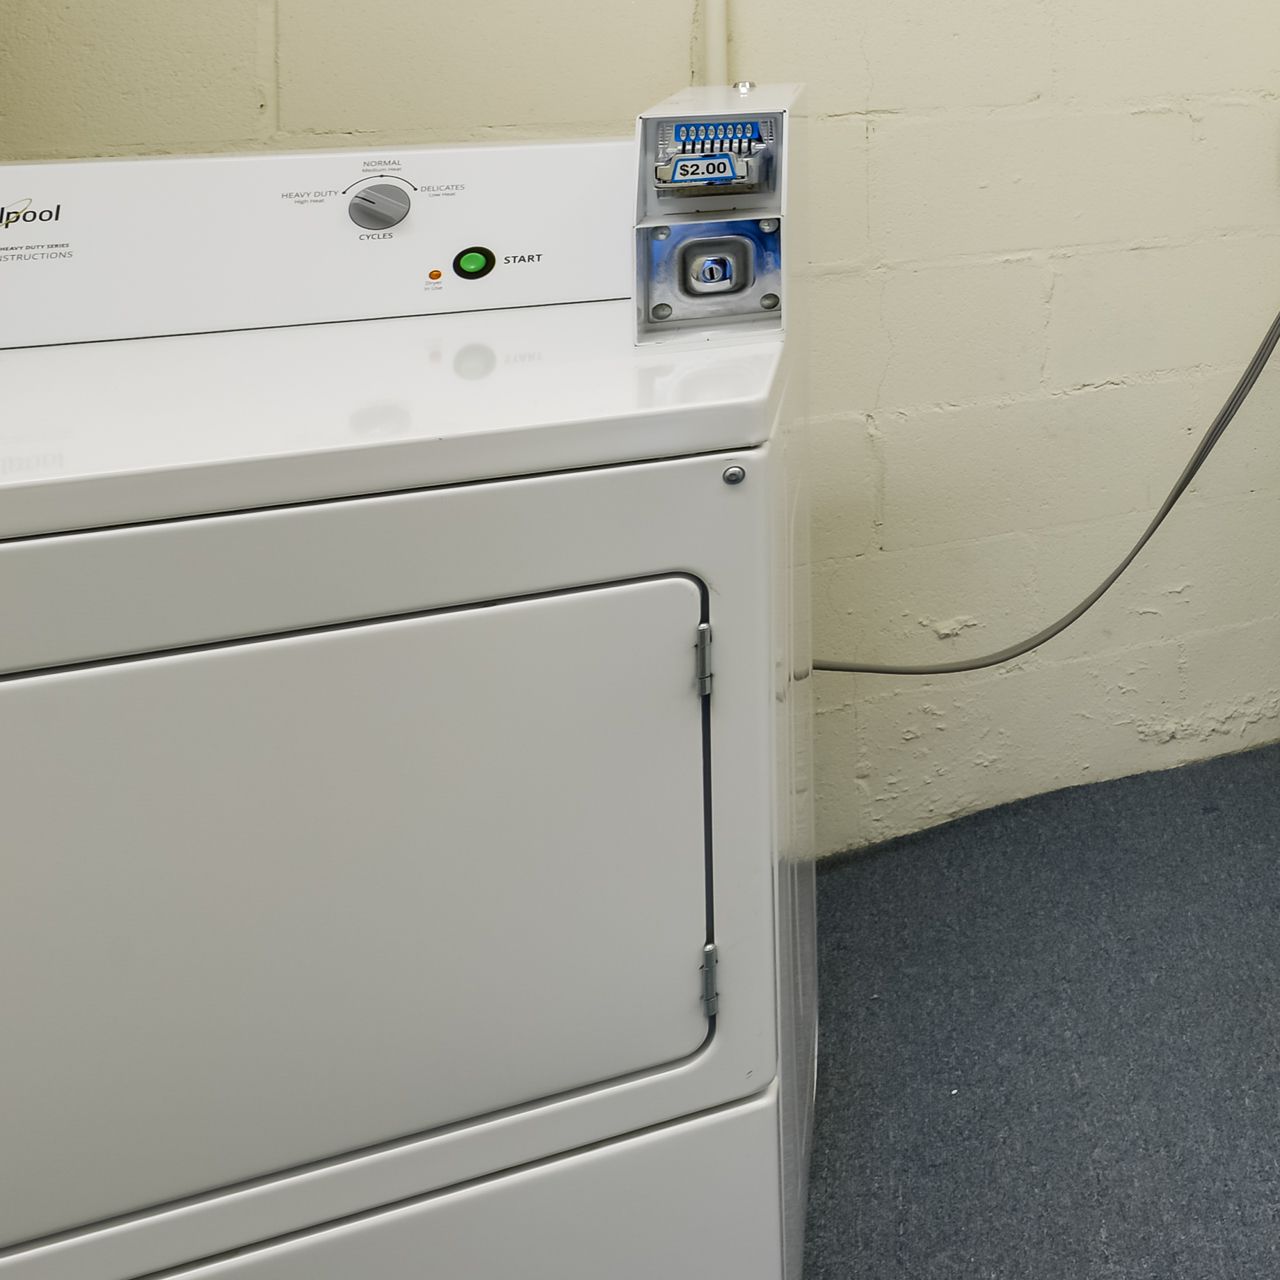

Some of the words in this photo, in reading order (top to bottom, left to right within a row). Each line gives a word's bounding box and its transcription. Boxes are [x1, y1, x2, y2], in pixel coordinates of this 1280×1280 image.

[680, 162, 727, 177] $2.00
[421, 184, 465, 192] DELICATES
[314, 190, 338, 198] DUTY
[503, 252, 543, 265] START
